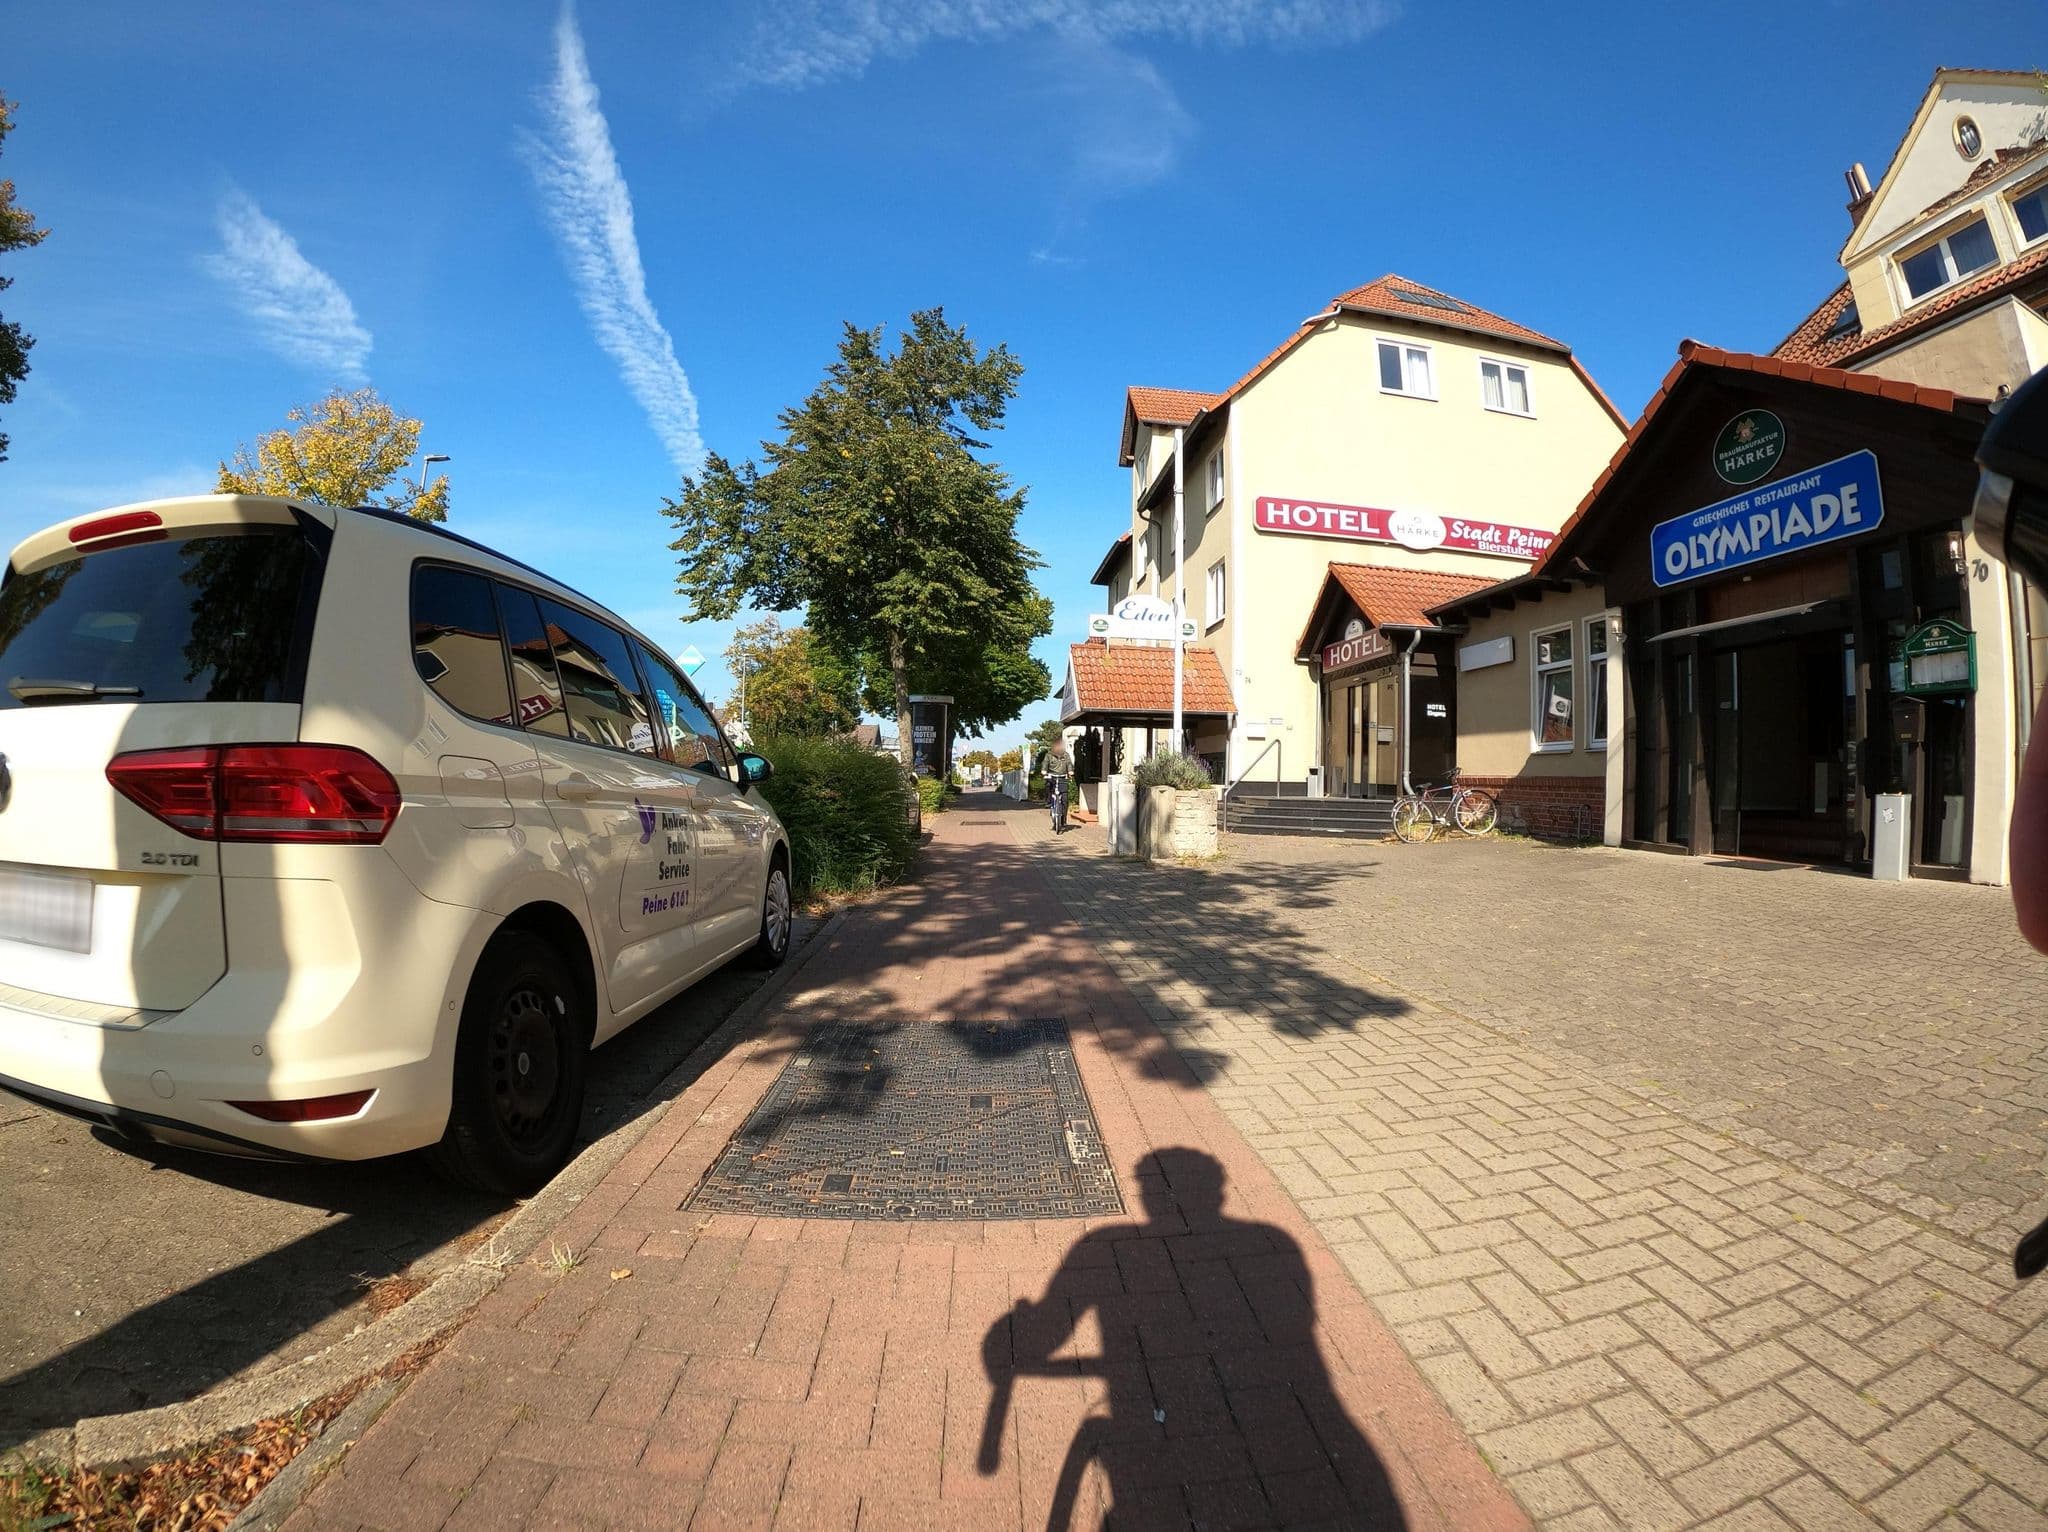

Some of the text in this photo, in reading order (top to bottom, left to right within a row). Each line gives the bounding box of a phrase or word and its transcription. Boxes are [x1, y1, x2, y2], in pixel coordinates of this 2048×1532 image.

[1725, 444, 1775, 472] HÄRKE
[1693, 475, 1821, 528] GRIECHISCHES RESTAURANT
[1266, 502, 1380, 535] HOTEL
[1665, 482, 1862, 576] OLYMPIADE
[1396, 523, 1440, 538] HÄRKE
[1450, 521, 1502, 544] Stadt
[1971, 559, 1989, 582] 70
[1119, 601, 1170, 622] Eden
[1330, 634, 1383, 666] HOTEL
[662, 813, 687, 830] Ankes
[667, 836, 689, 855] Fahr-
[168, 854, 199, 867] TDI
[659, 859, 690, 880] Service
[642, 890, 689, 915] Peine 6161
